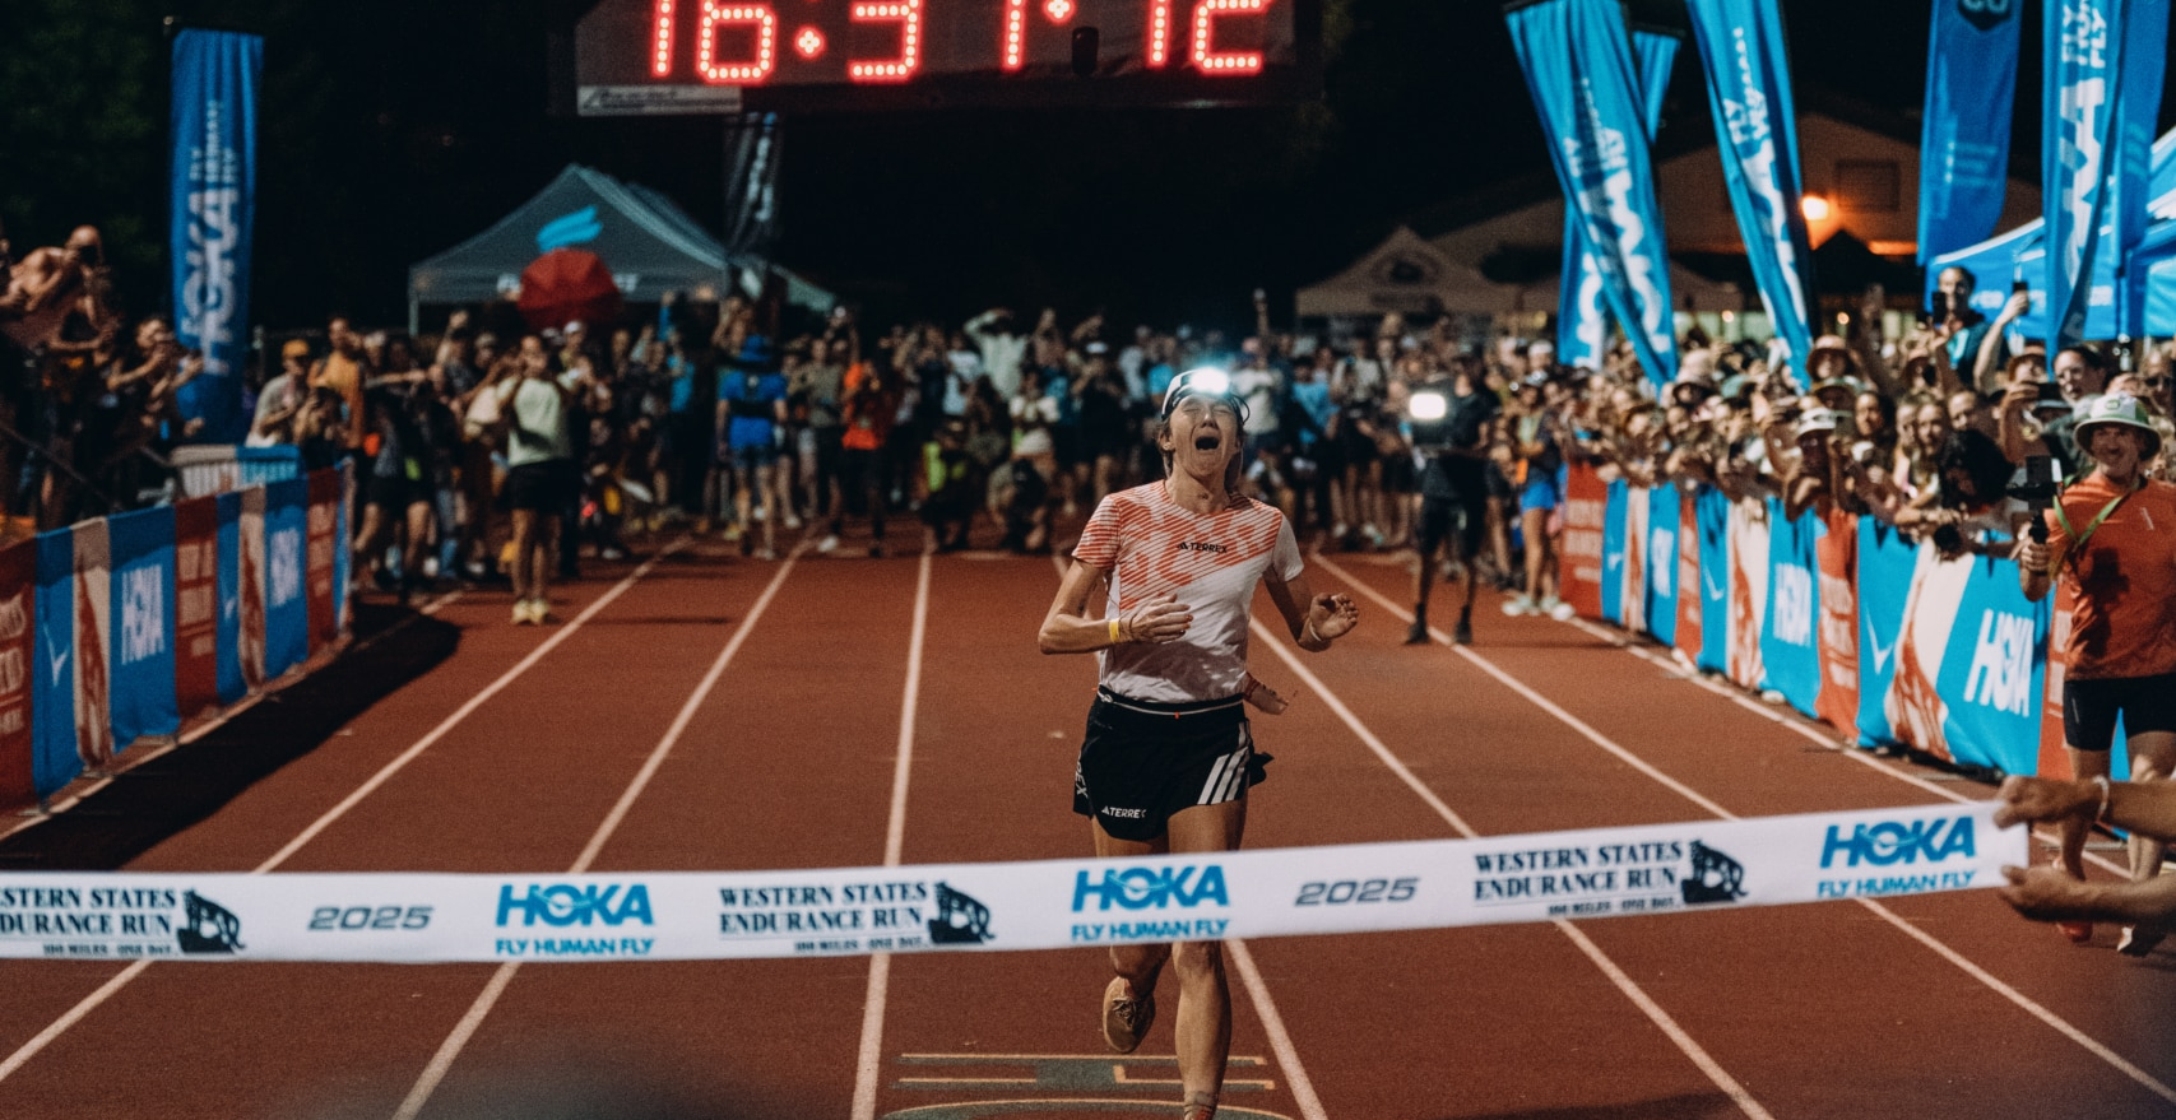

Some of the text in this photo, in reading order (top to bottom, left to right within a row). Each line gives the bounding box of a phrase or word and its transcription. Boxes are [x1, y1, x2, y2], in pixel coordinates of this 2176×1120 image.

[1190, 542, 1227, 553] TERREX
[1963, 608, 2035, 718] HOKA
[1819, 816, 1976, 868] HOKA
[1475, 841, 1682, 872] WESTERN STATES
[720, 882, 927, 907] WESTERN STATES
[1072, 865, 1229, 912] HOKA
[1294, 876, 1420, 907] 2025
[1475, 866, 1676, 900] ENDURANCE RUN
[1818, 871, 1975, 897] FLY HUMAN FLY
[91, 888, 175, 908] STATES
[496, 884, 654, 926] HOKA
[122, 913, 171, 934] RUN
[308, 905, 434, 931] 2025
[721, 907, 922, 933] ENDURANCE RUN
[1072, 919, 1229, 941] FLY HUMAN FLY
[496, 937, 654, 955] FLY HUMAN FLY
